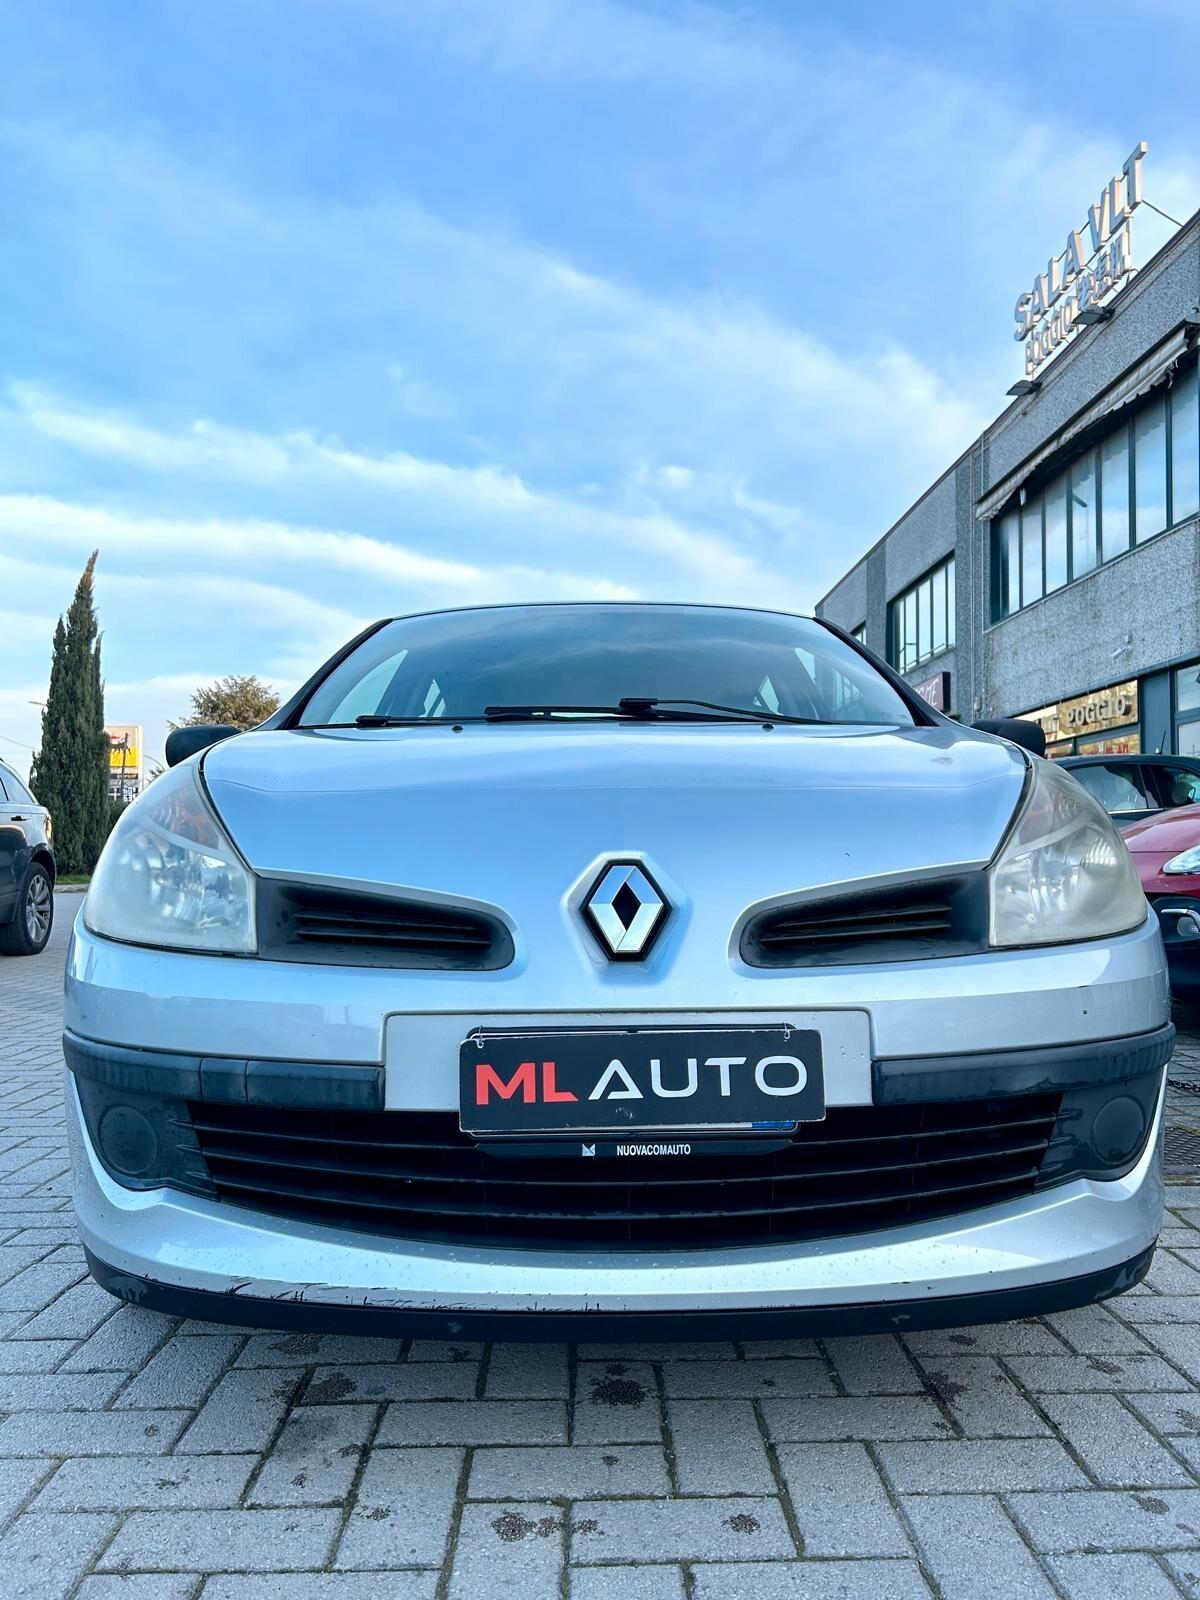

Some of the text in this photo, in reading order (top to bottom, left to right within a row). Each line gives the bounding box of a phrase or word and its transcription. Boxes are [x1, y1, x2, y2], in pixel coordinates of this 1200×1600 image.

[1014, 230, 1088, 342] SALA
[1088, 140, 1149, 252] VLT
[1067, 695, 1126, 727] POGGIO
[475, 1055, 808, 1105] ML AUTO
[616, 1143, 692, 1157] NUOVACOMAUTO
